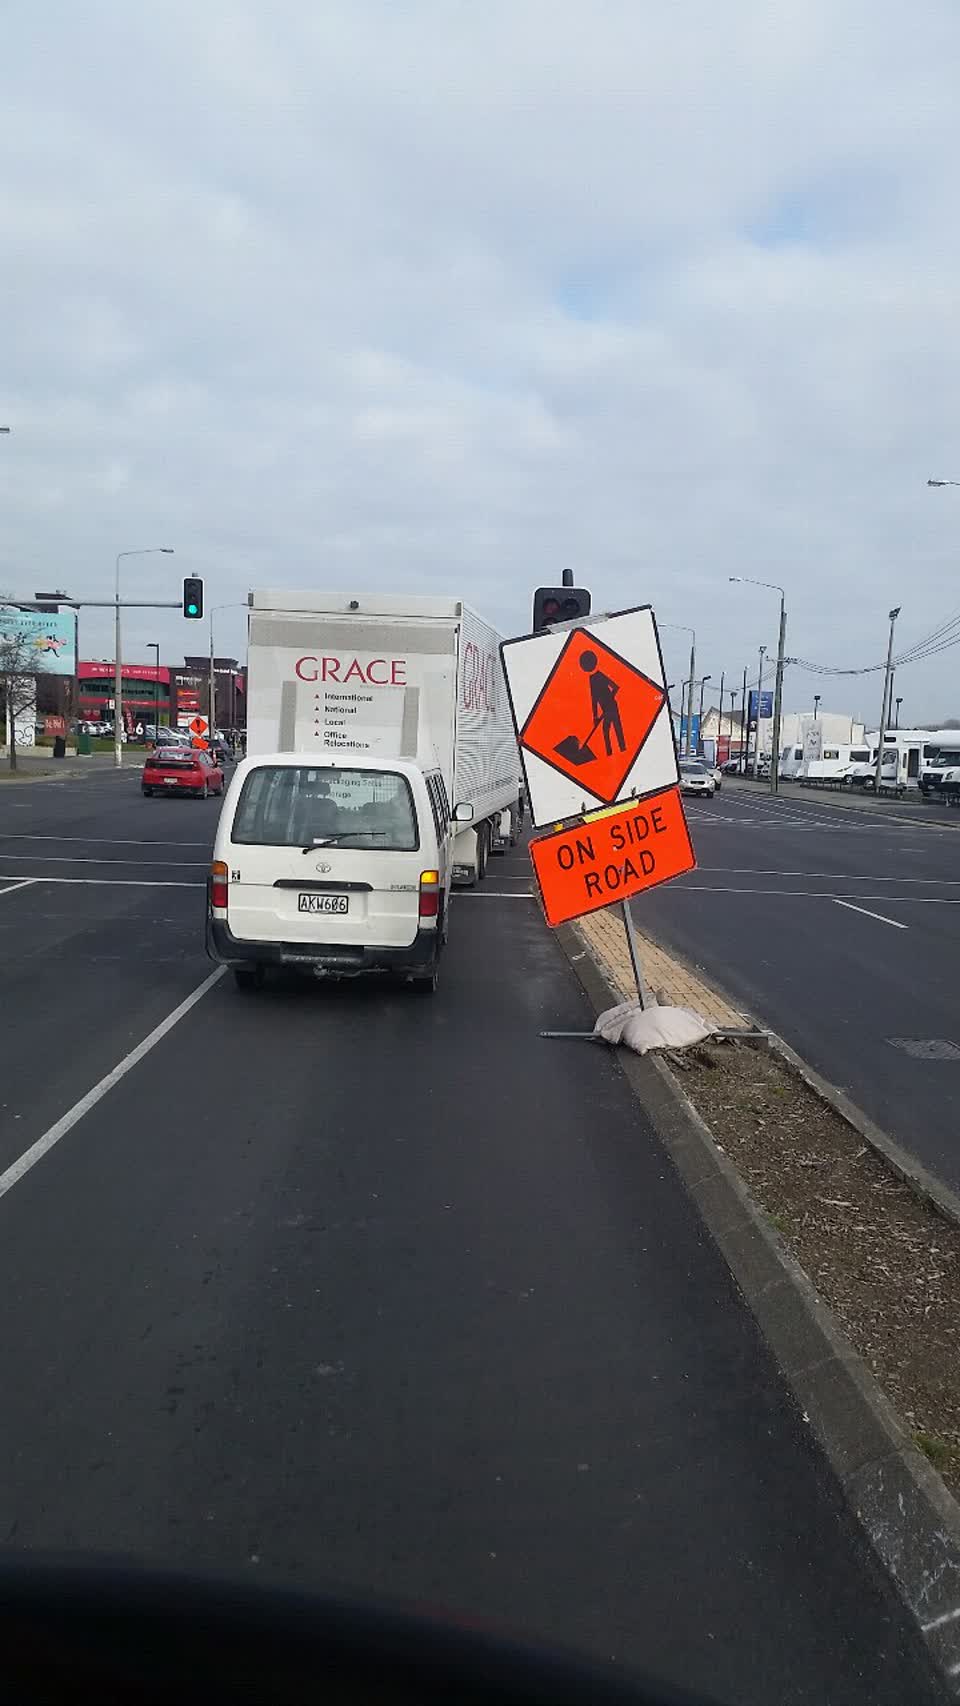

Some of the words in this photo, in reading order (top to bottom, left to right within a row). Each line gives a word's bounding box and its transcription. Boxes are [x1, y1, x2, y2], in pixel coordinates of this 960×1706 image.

[295, 656, 407, 686] GRACE
[324, 692, 373, 702] International
[324, 705, 357, 714] National
[324, 718, 346, 726] Local
[324, 730, 347, 739] Office
[324, 739, 370, 749] Relocations
[557, 836, 595, 871] ON
[612, 806, 668, 851] SIDE
[584, 849, 656, 898] ROAD
[301, 895, 347, 912] AKW606
